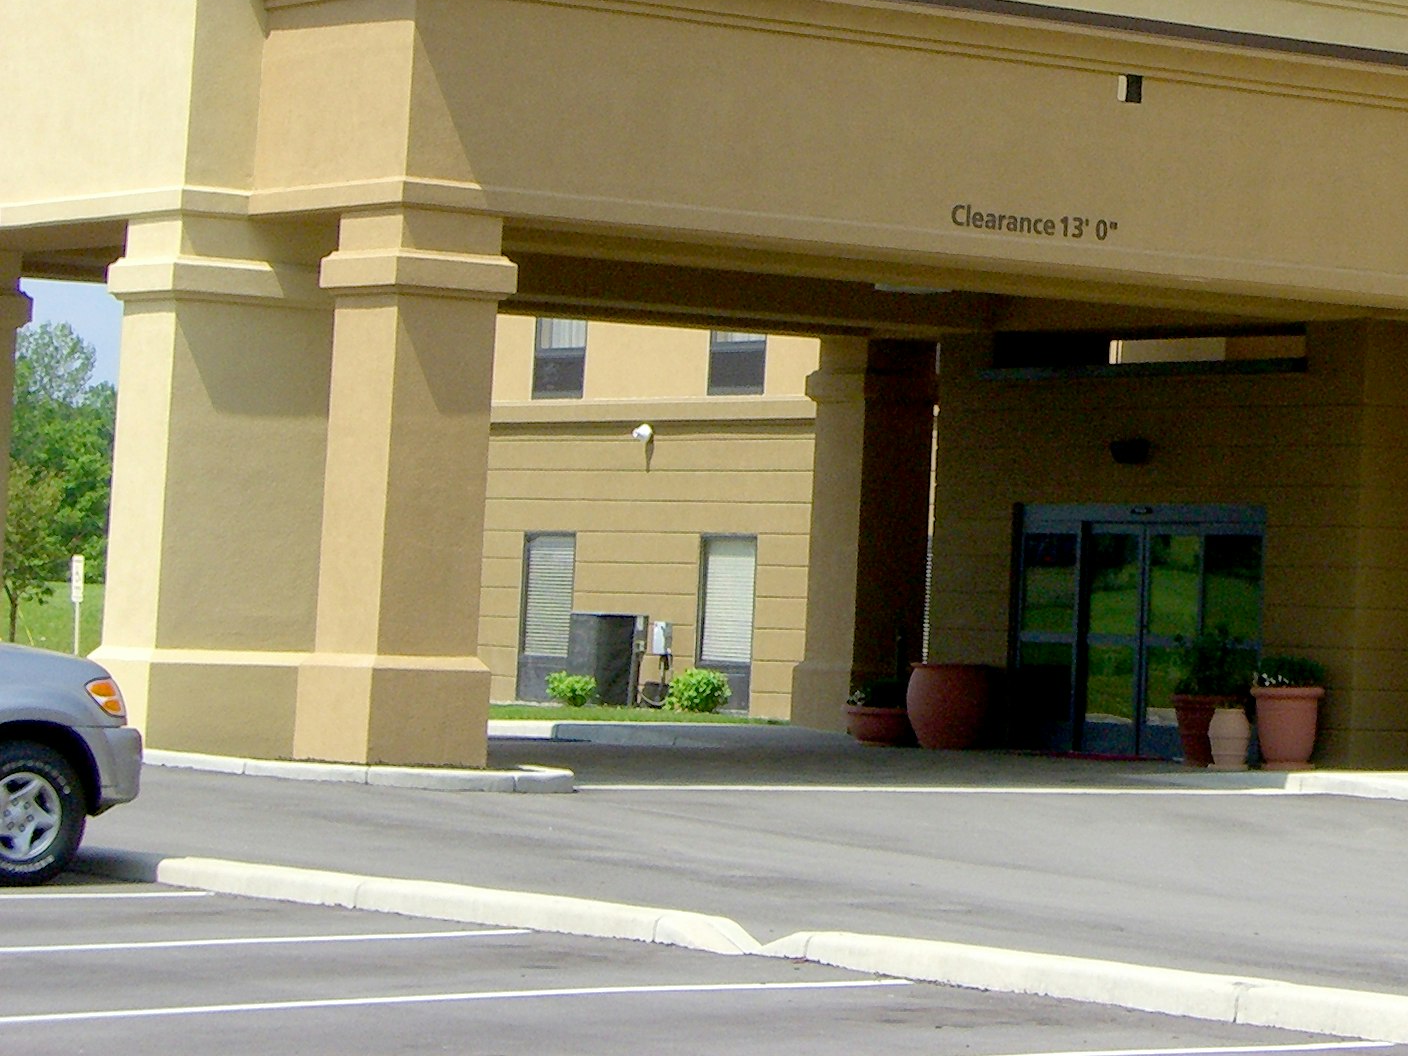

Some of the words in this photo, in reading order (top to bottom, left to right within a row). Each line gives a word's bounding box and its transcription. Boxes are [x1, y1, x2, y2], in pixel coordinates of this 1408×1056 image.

[951, 204, 1056, 236] Clearance
[1060, 216, 1090, 238] 13'
[1095, 219, 1119, 241] 0"
